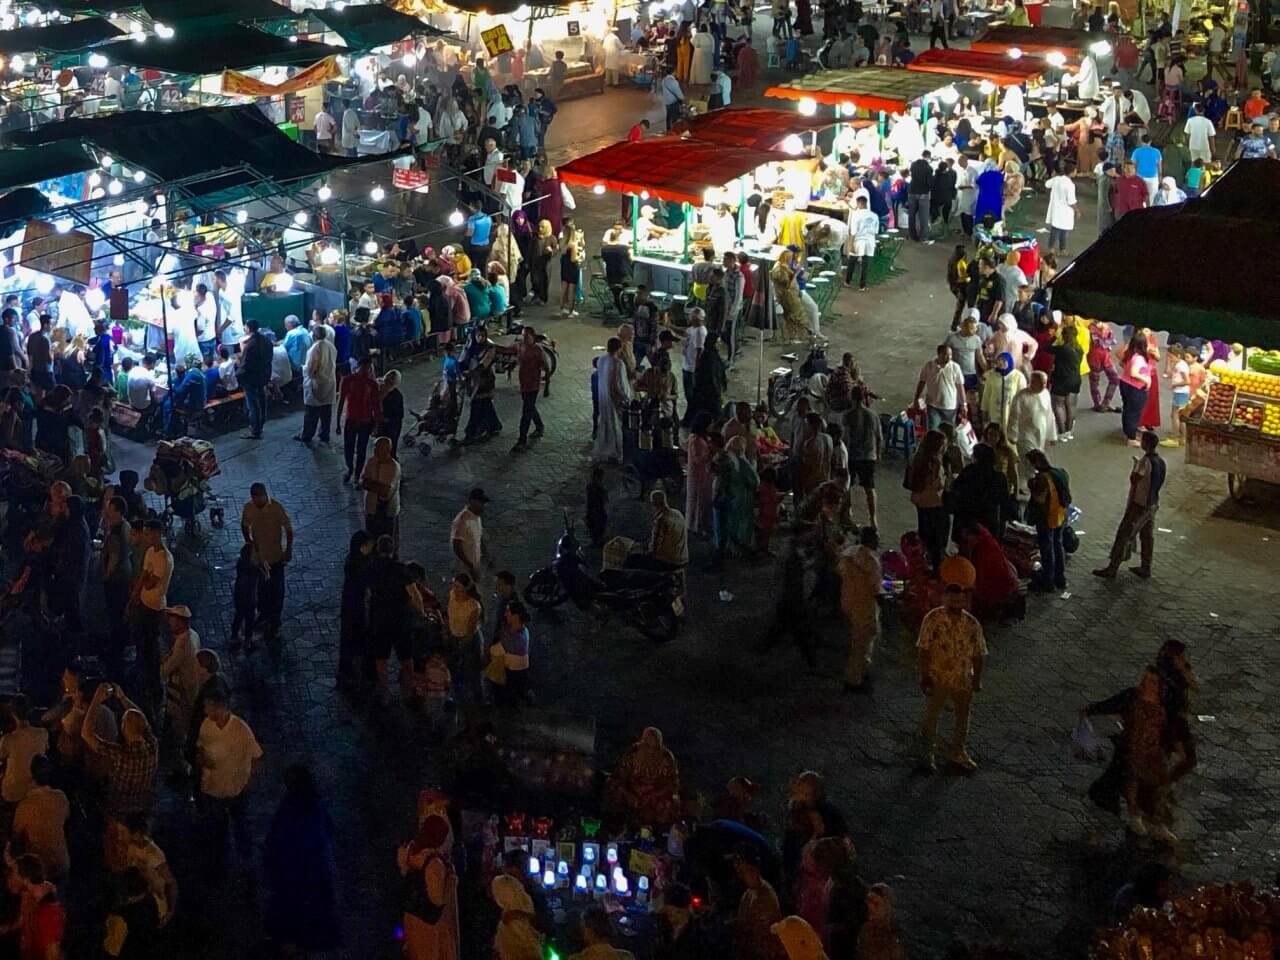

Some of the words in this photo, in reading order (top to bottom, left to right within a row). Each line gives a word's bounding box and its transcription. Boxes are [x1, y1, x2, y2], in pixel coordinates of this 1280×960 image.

[486, 35, 511, 56] 14
[37, 66, 51, 81] 42
[91, 77, 104, 91] 42
[163, 90, 179, 103] 42
